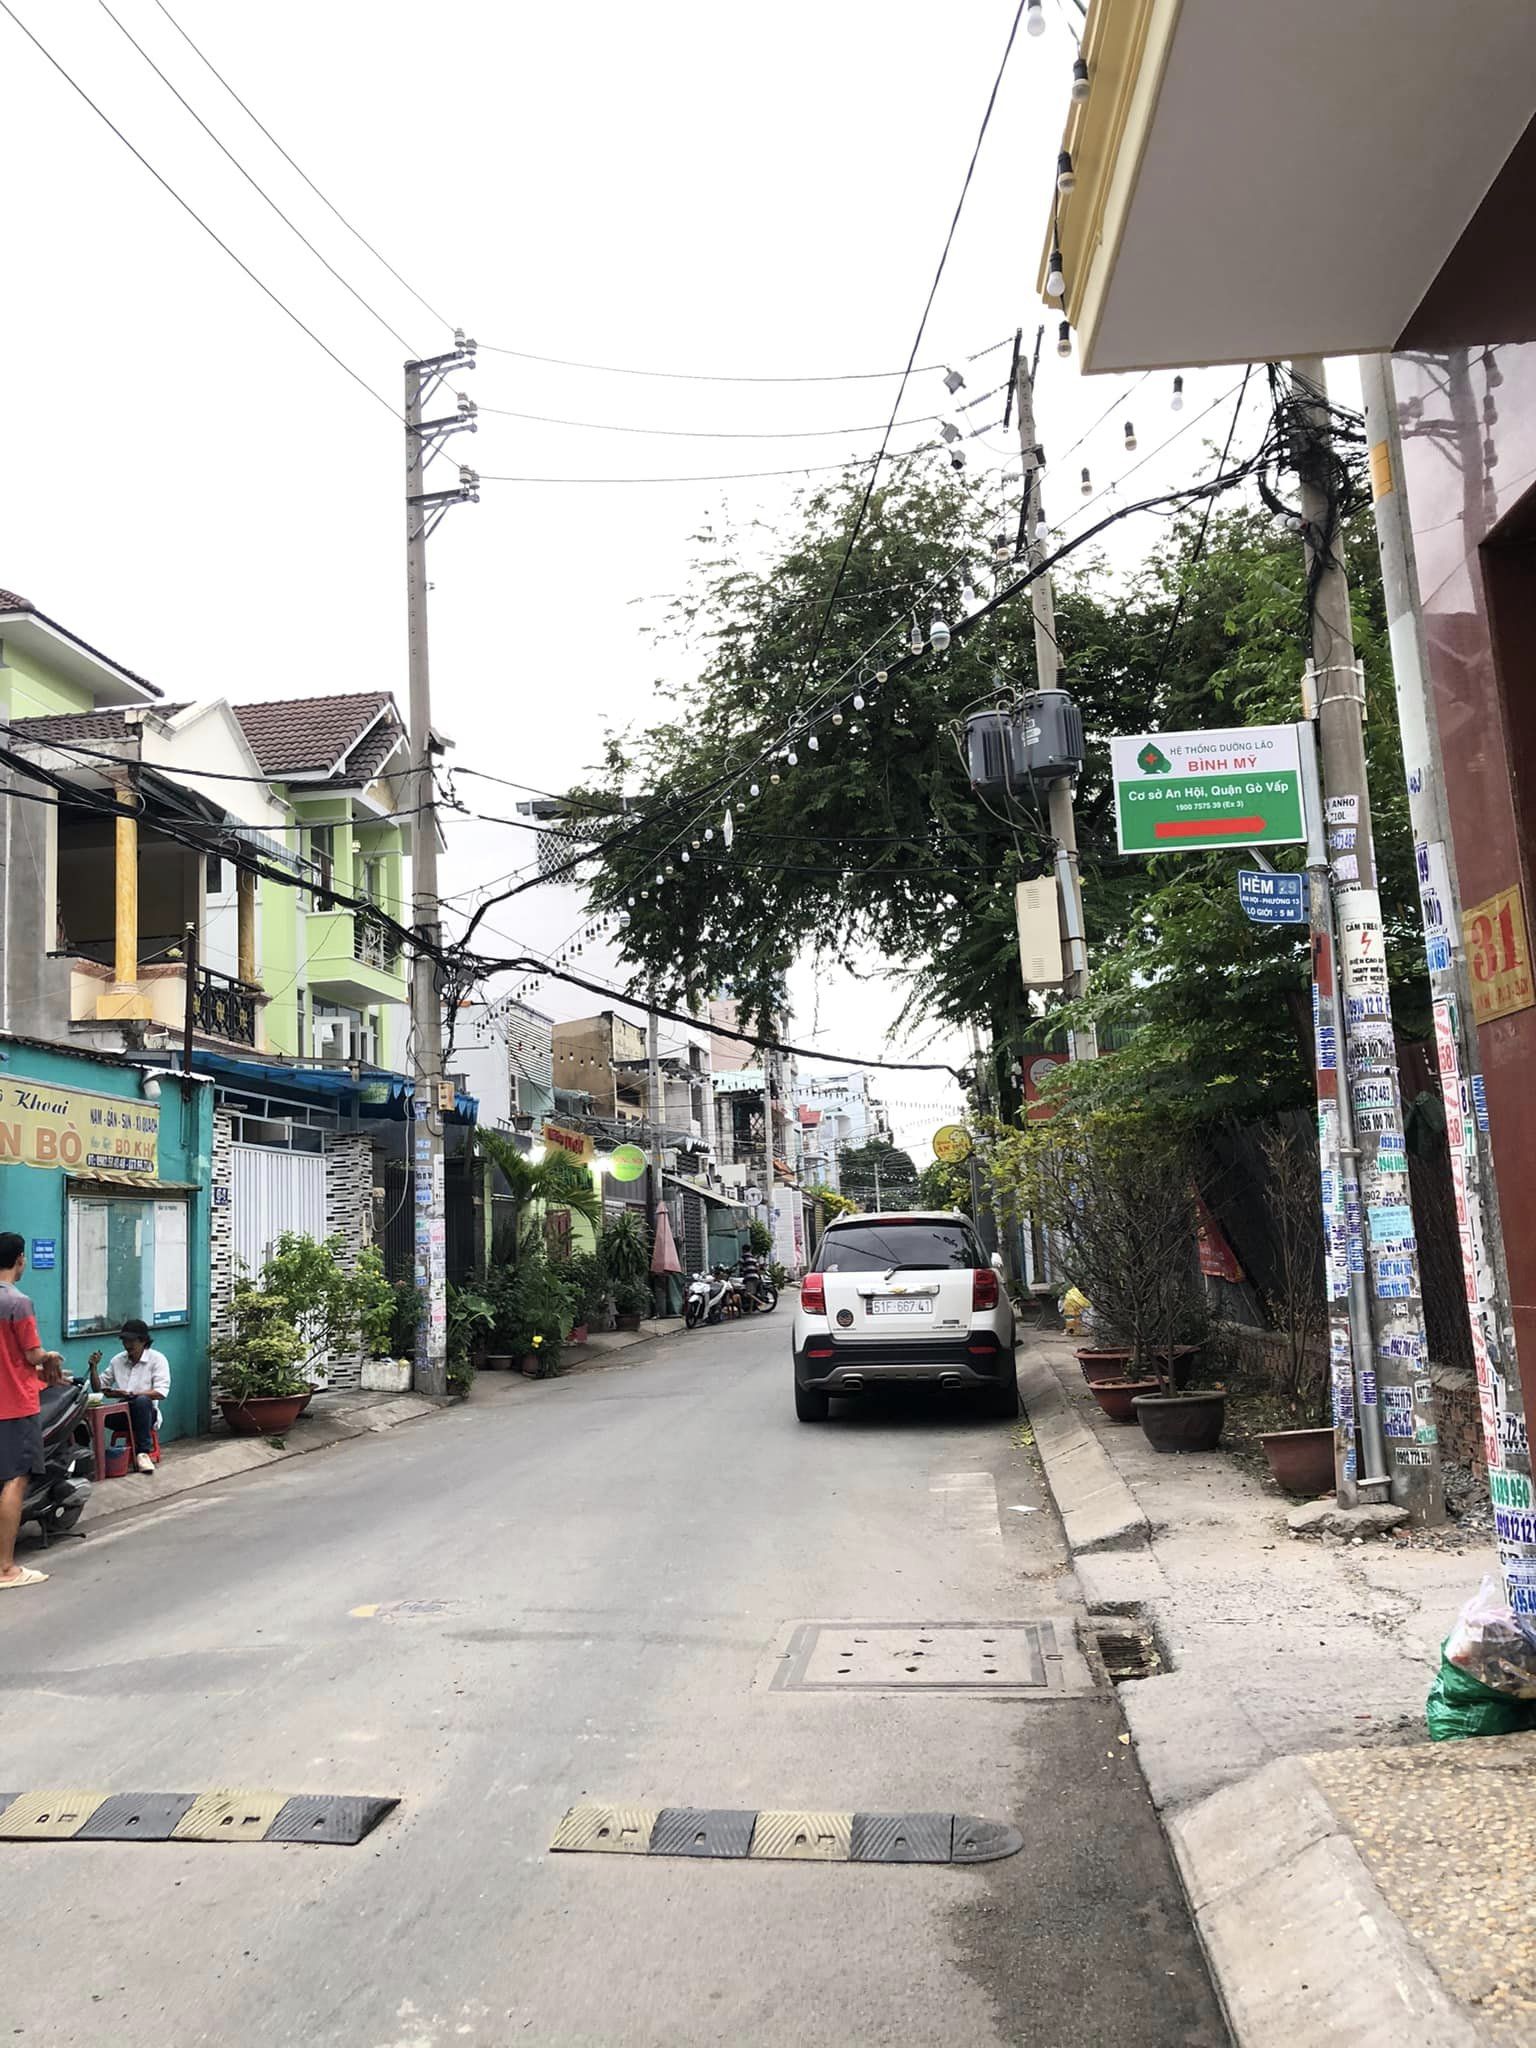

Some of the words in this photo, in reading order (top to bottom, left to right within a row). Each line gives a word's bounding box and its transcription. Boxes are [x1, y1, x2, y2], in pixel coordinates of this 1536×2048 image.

[1188, 757, 1228, 772] BÌNH
[1234, 753, 1258, 769] MỸ
[1128, 790, 1146, 802] Cơ
[1148, 787, 1162, 800] sở
[1165, 789, 1181, 799] An
[1185, 785, 1209, 800] Hội,
[1211, 784, 1242, 797] Quận
[1245, 782, 1263, 794] Gò
[1265, 779, 1289, 794] Vấp
[1175, 803, 1193, 812] 1900
[1242, 875, 1274, 895] HẺM
[1472, 901, 1523, 983] 31
[14, 1089, 69, 1115] Khoai
[36, 1121, 82, 1164] BÒ
